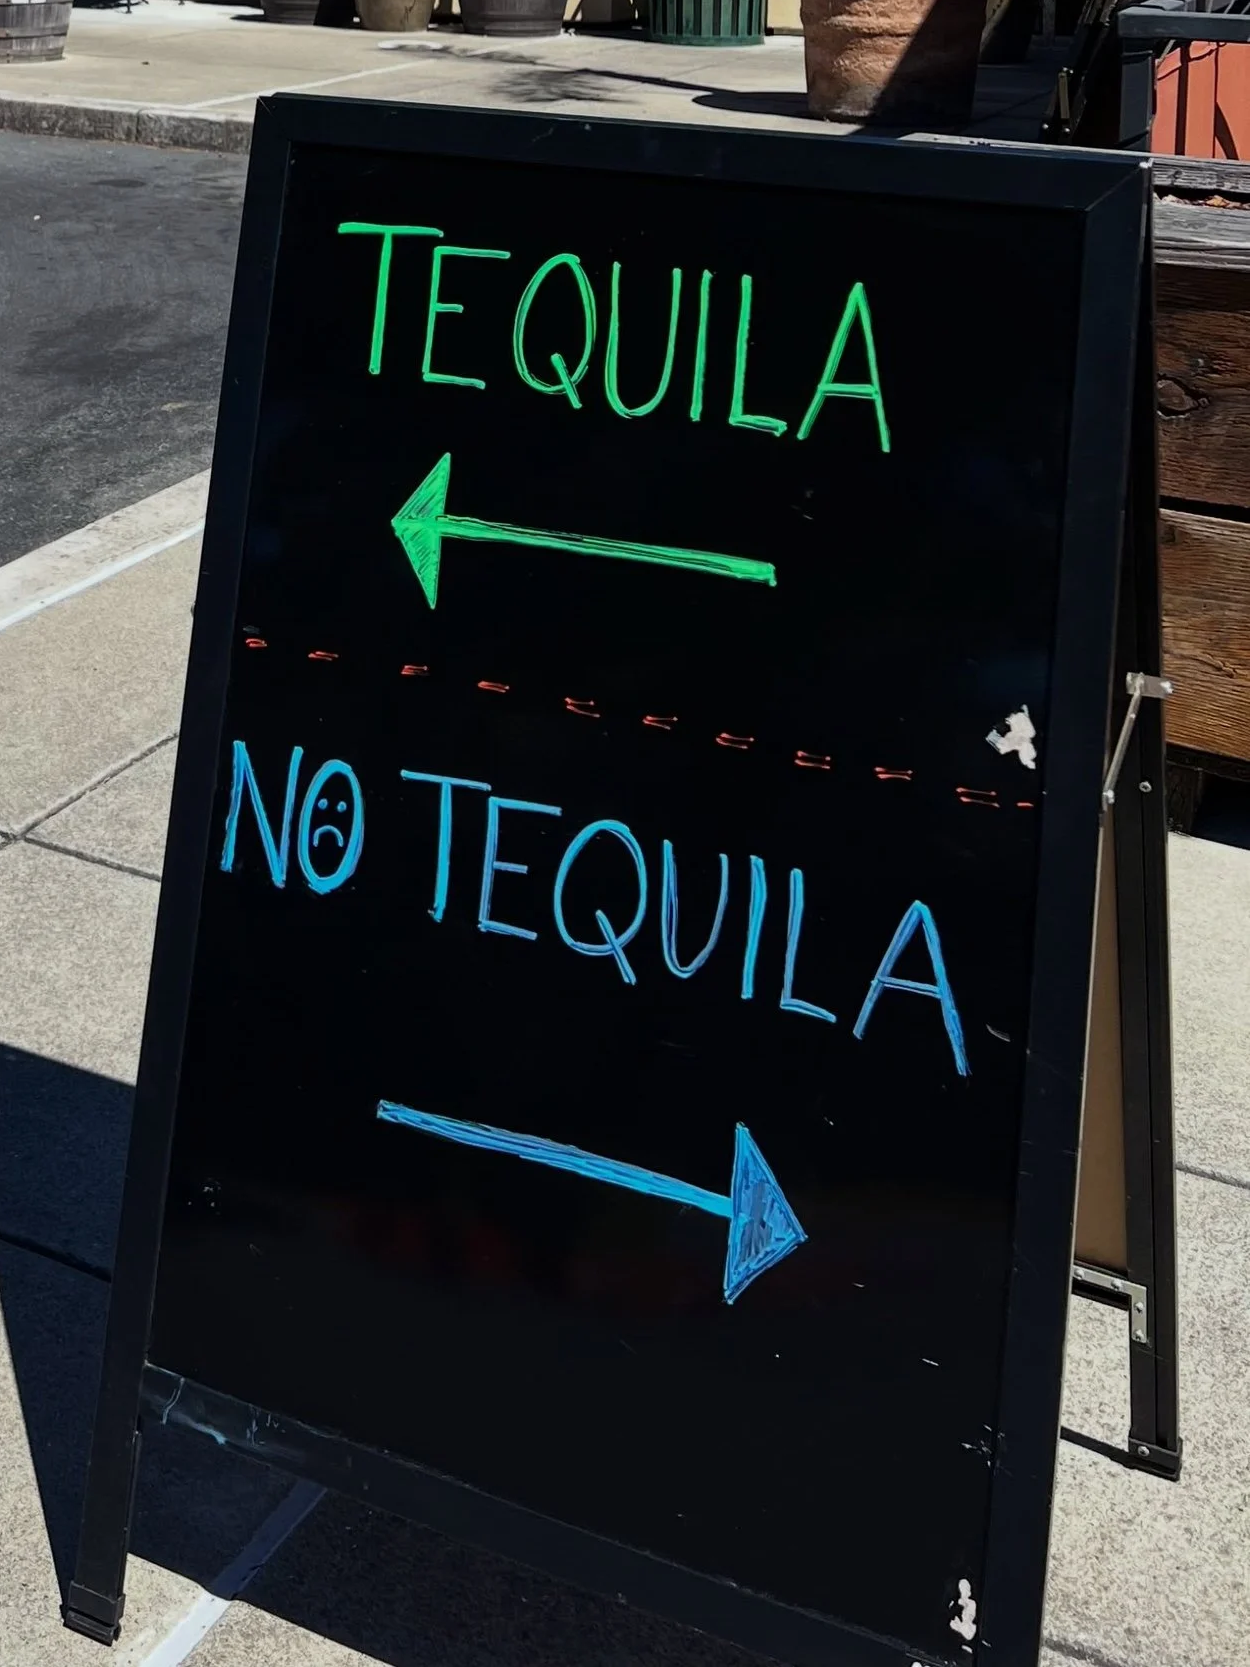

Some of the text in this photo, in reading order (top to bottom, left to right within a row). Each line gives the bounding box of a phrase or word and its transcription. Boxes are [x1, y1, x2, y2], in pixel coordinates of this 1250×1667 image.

[338, 221, 892, 453] TEQUILA
[219, 739, 971, 1077] NO TEQUILA
